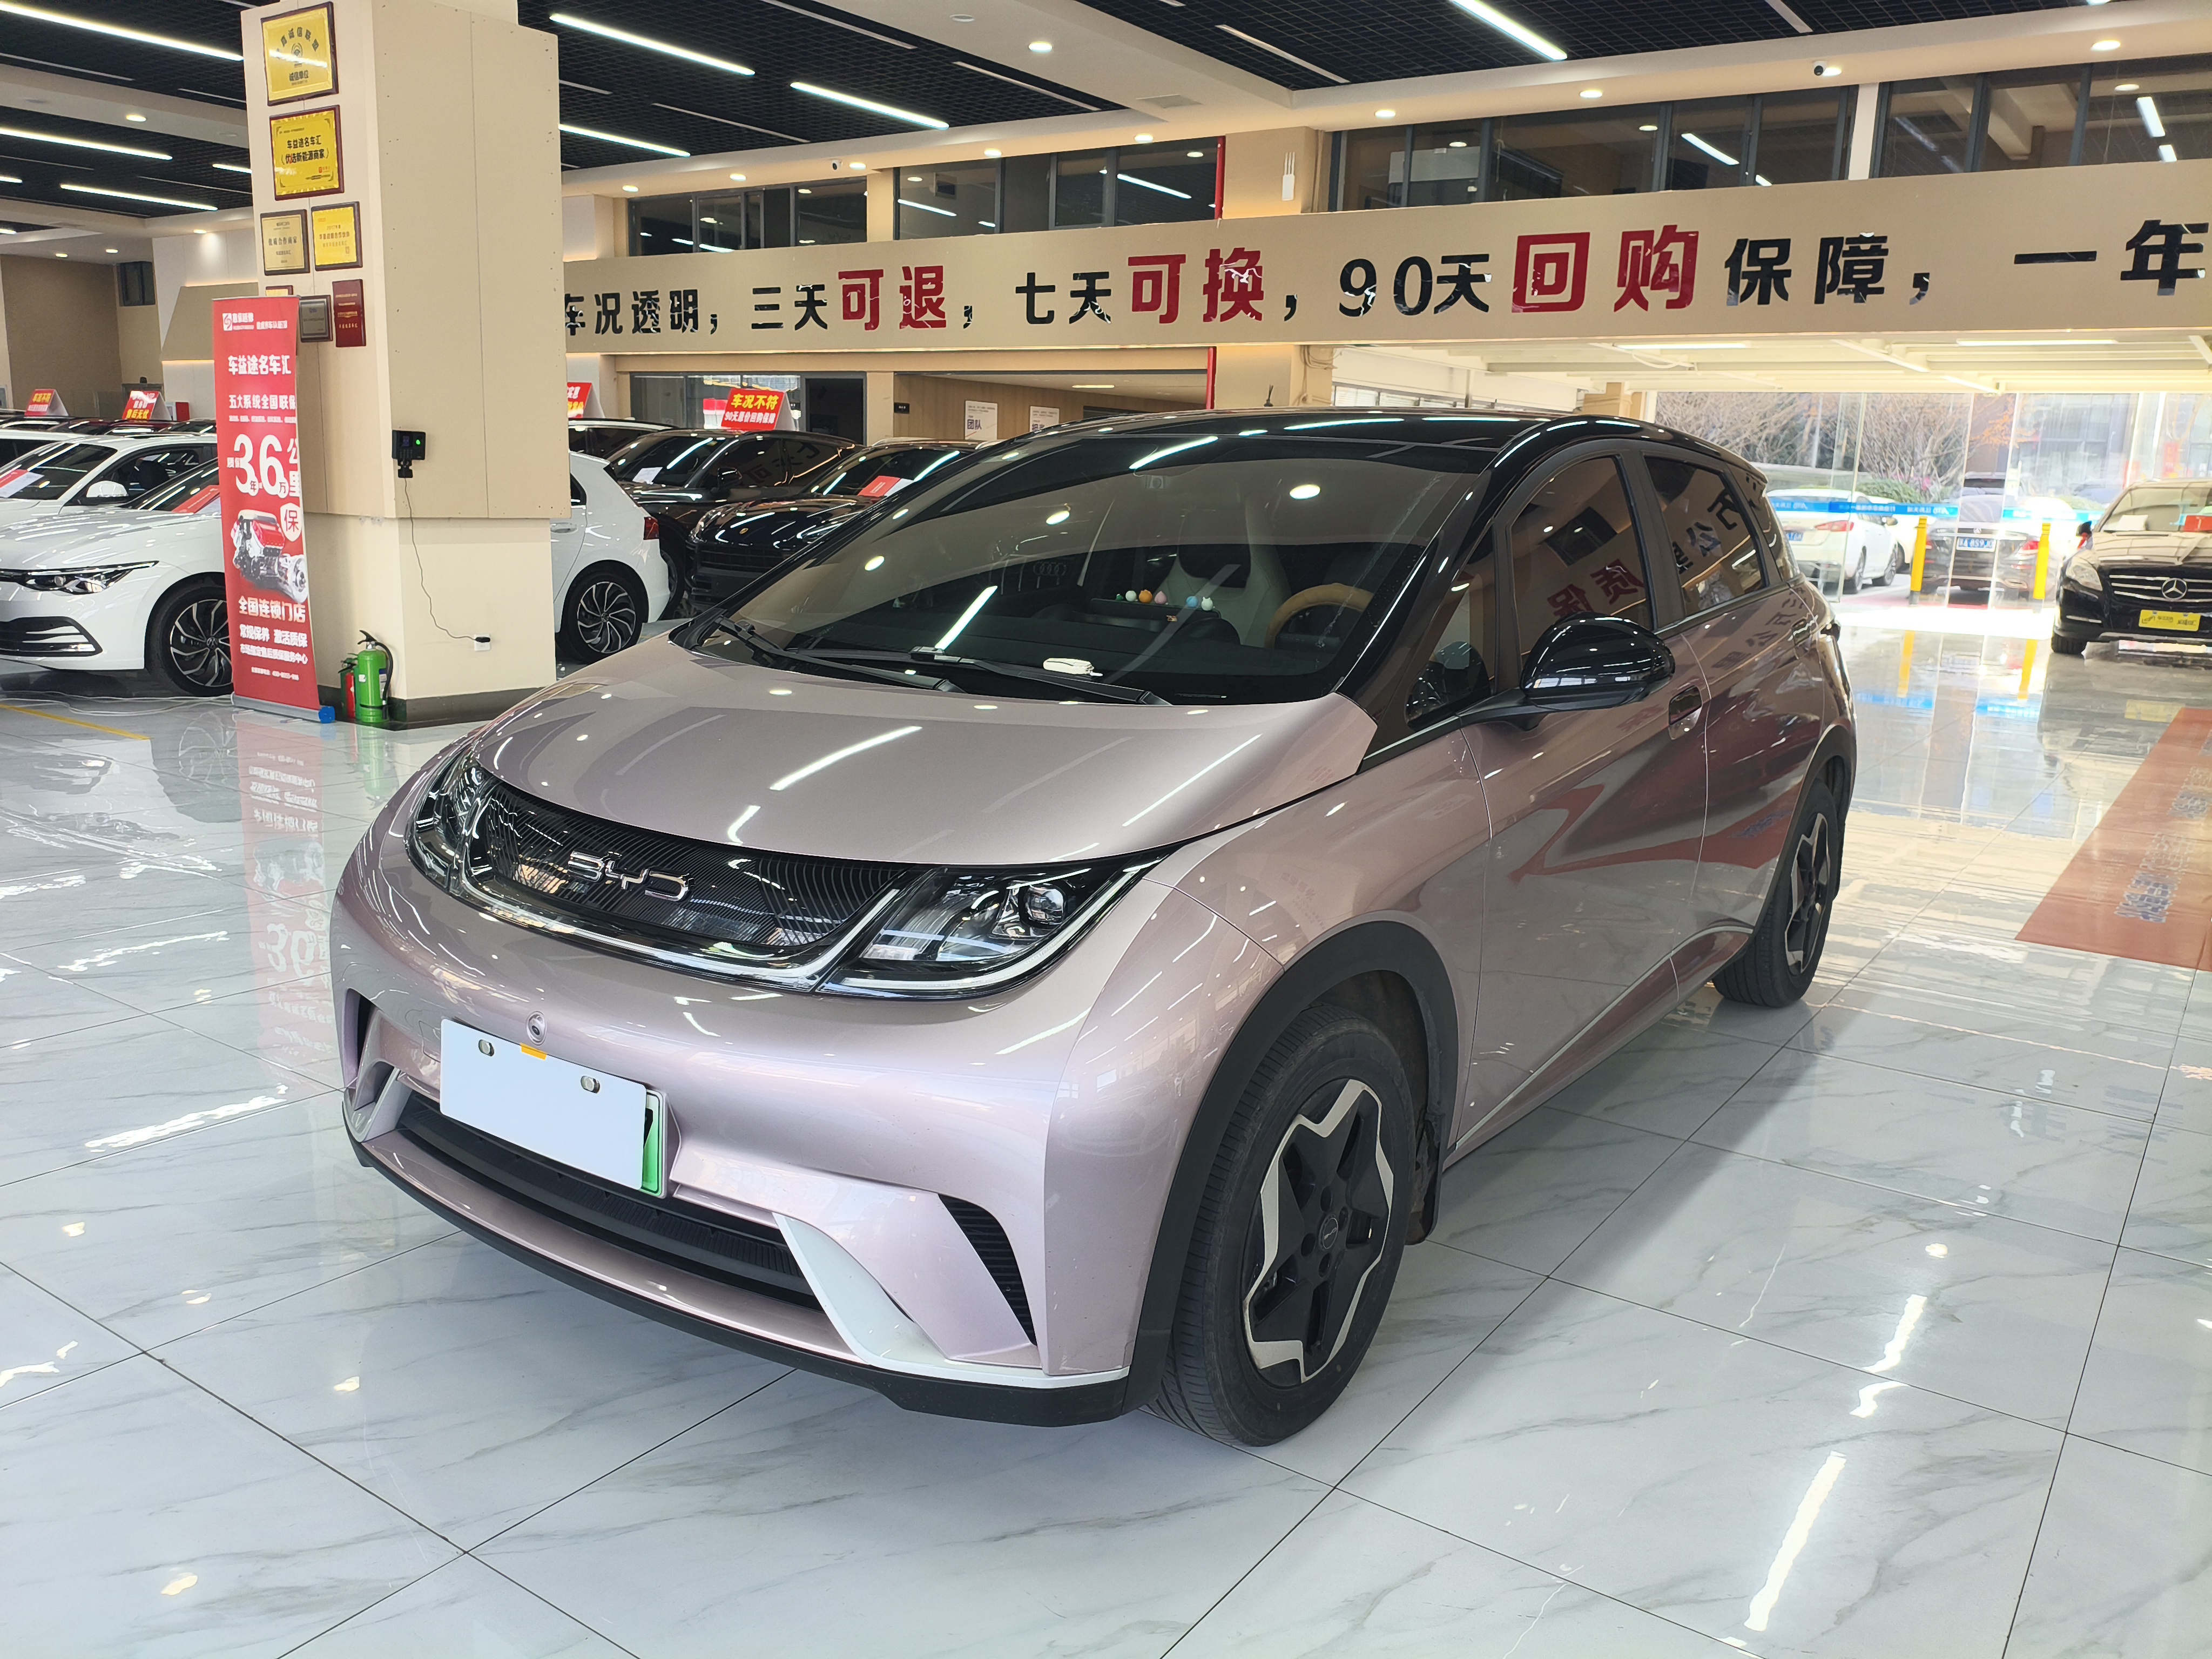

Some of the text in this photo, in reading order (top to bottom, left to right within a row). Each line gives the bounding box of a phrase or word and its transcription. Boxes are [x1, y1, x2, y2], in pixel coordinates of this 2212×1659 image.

[287, 135, 321, 149] 车益途名车汇
[2014, 220, 2209, 296] 一年
[228, 354, 291, 375] 车益途名车汇
[229, 394, 296, 410] 五大系统全国联保
[731, 393, 779, 410] 车况不符
[967, 419, 982, 430] 团队
[284, 509, 299, 532] 保
[239, 596, 306, 623] 全国连锁门店
[240, 624, 308, 648] 常规保养 激活质保
[568, 849, 694, 902] BYD
